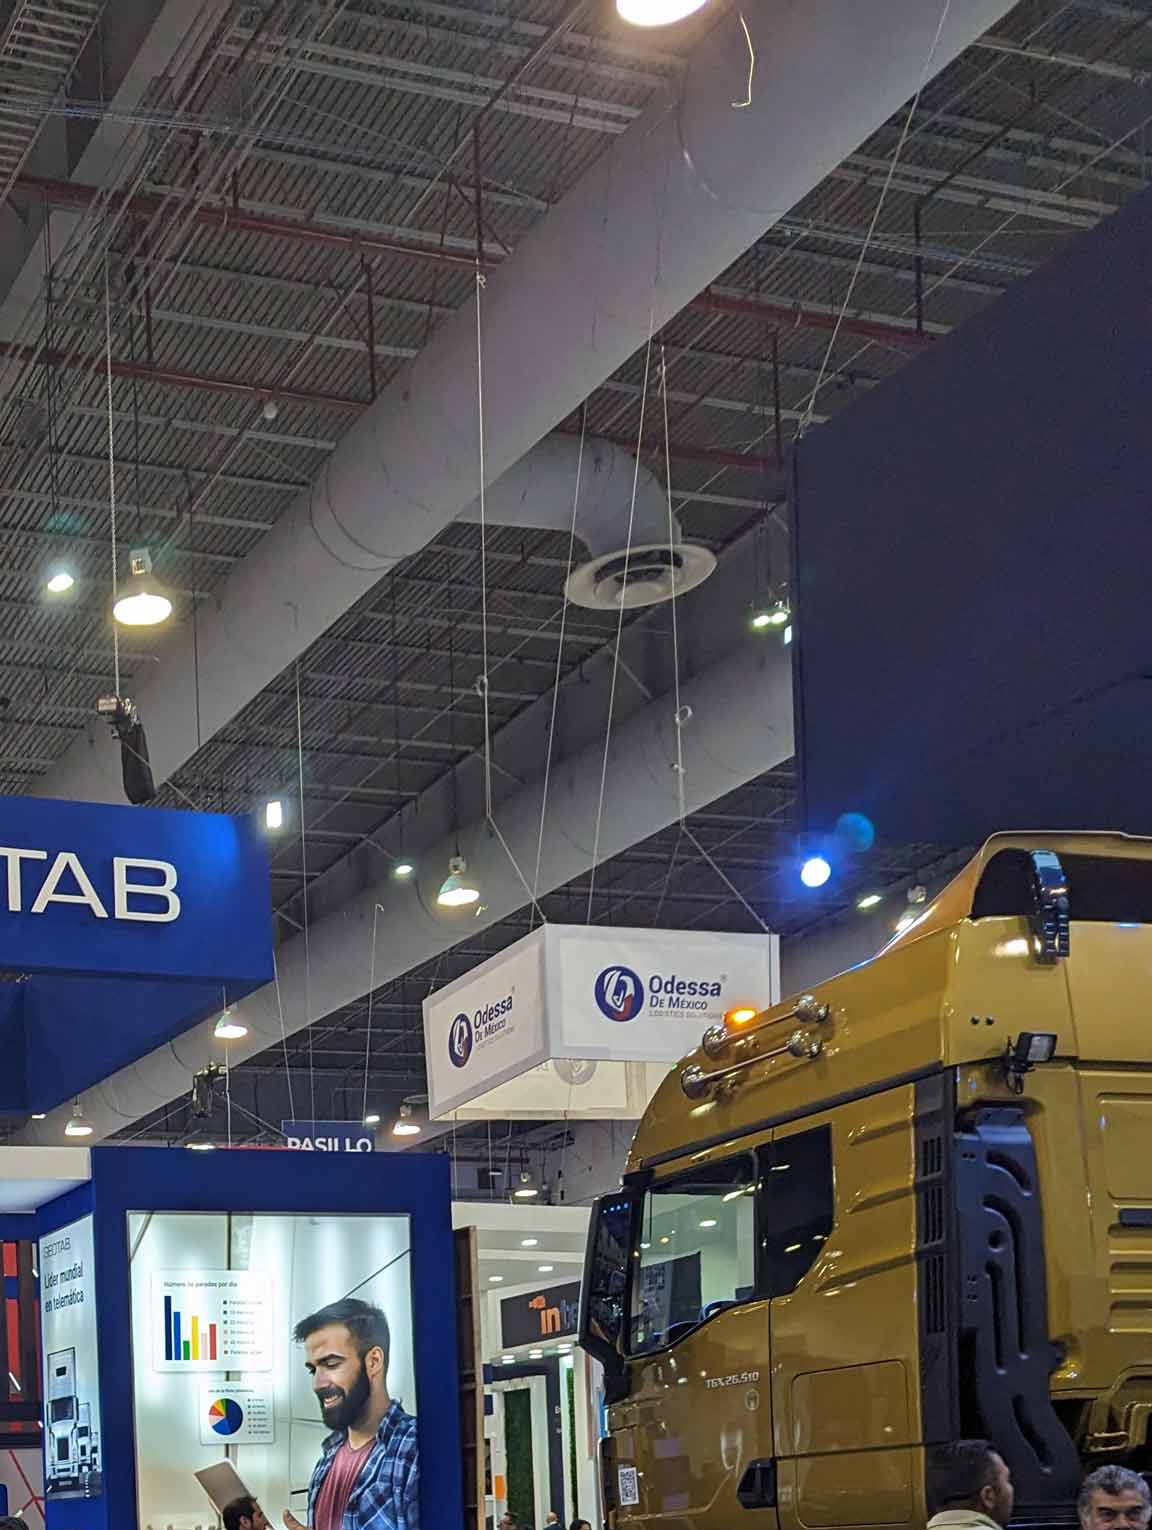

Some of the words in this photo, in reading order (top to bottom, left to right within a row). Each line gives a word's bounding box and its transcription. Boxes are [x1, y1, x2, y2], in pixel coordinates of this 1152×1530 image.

[649, 974, 722, 997] Odessa
[474, 995, 513, 1030] Odessa
[60, 1260, 83, 1282] mundial
[45, 1300, 52, 1312] en
